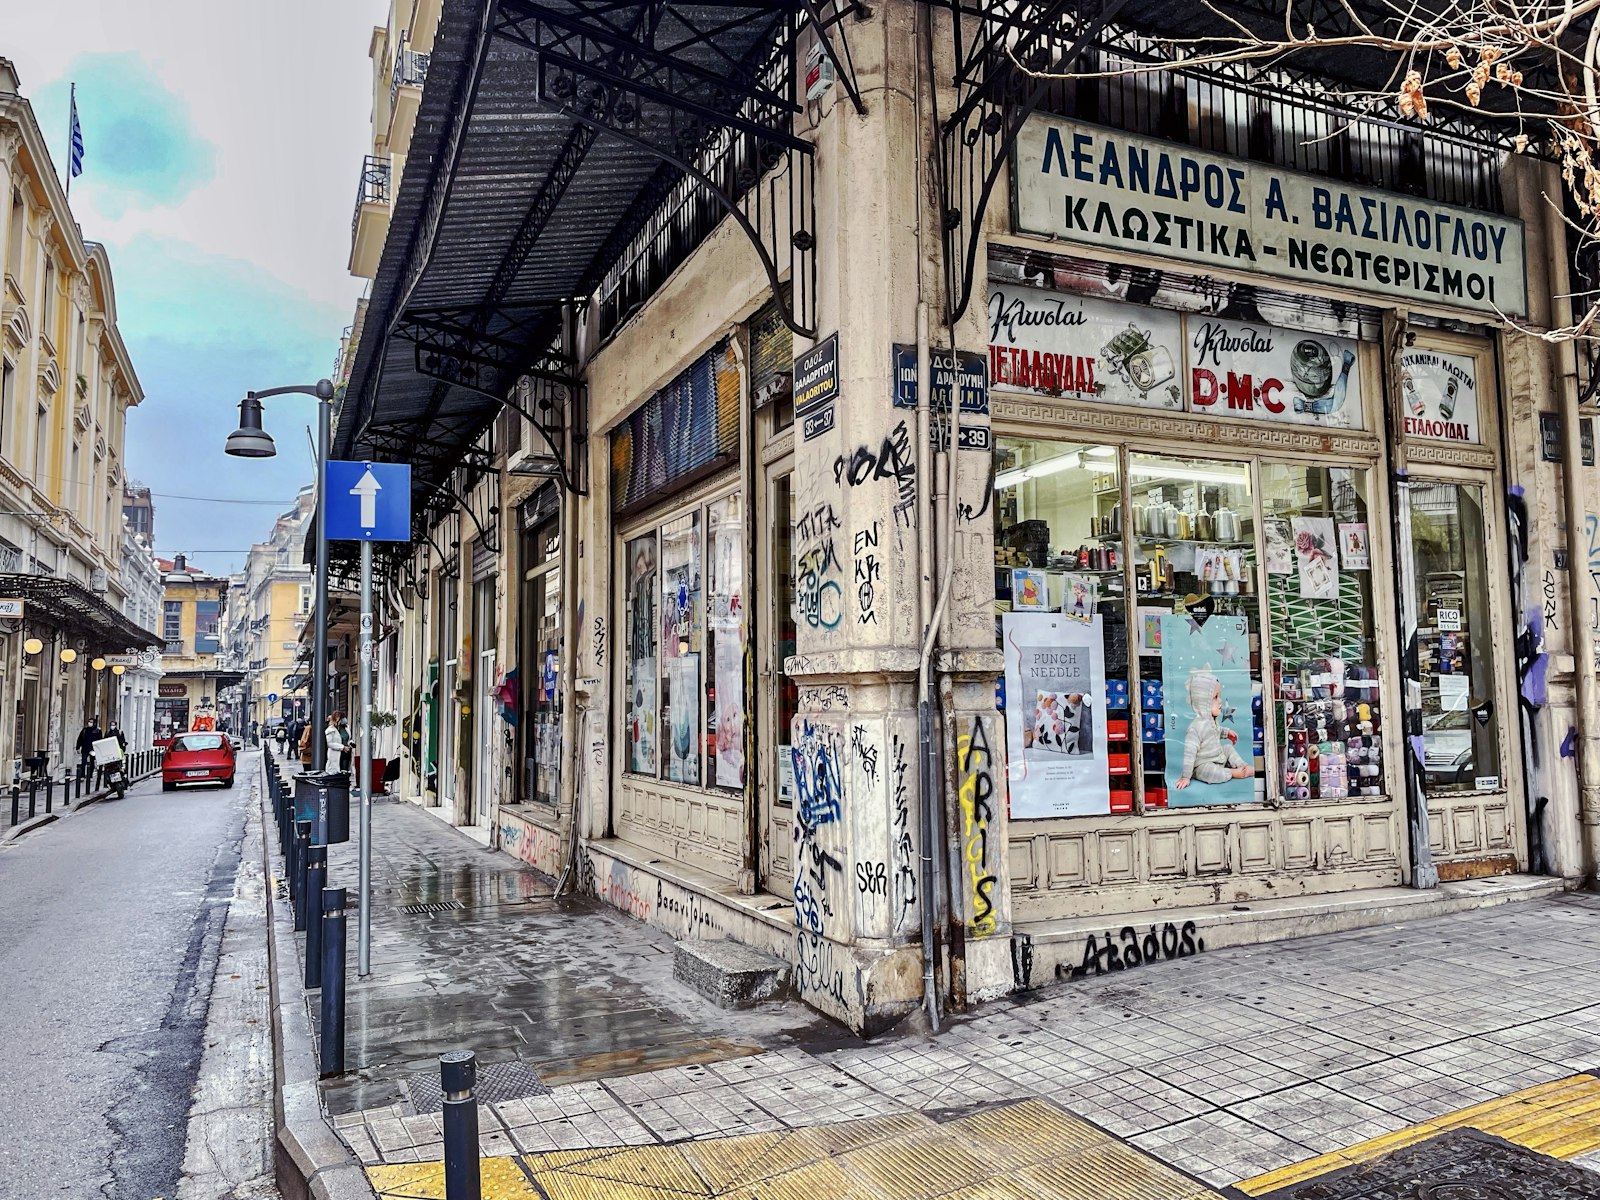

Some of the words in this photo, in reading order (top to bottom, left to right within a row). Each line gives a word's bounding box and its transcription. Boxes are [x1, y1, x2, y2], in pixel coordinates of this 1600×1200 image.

[1041, 126, 1246, 215] ΛΕΑΝΔΡΟΣ
[1312, 186, 1507, 264] ΒΑΣΙΛΟΓΛΟΥ
[1064, 194, 1257, 262] ΚΛΩΣΤΙΚΑ
[1288, 237, 1495, 304] ΝΕΩΤΕΡΙΣΜΟΙ
[968, 430, 986, 446] 39
[1403, 416, 1470, 441] ΕΤΑΛΟΥΔΑΣ
[1033, 653, 1077, 664] PUNCH
[1031, 667, 1081, 678] NEEDLE
